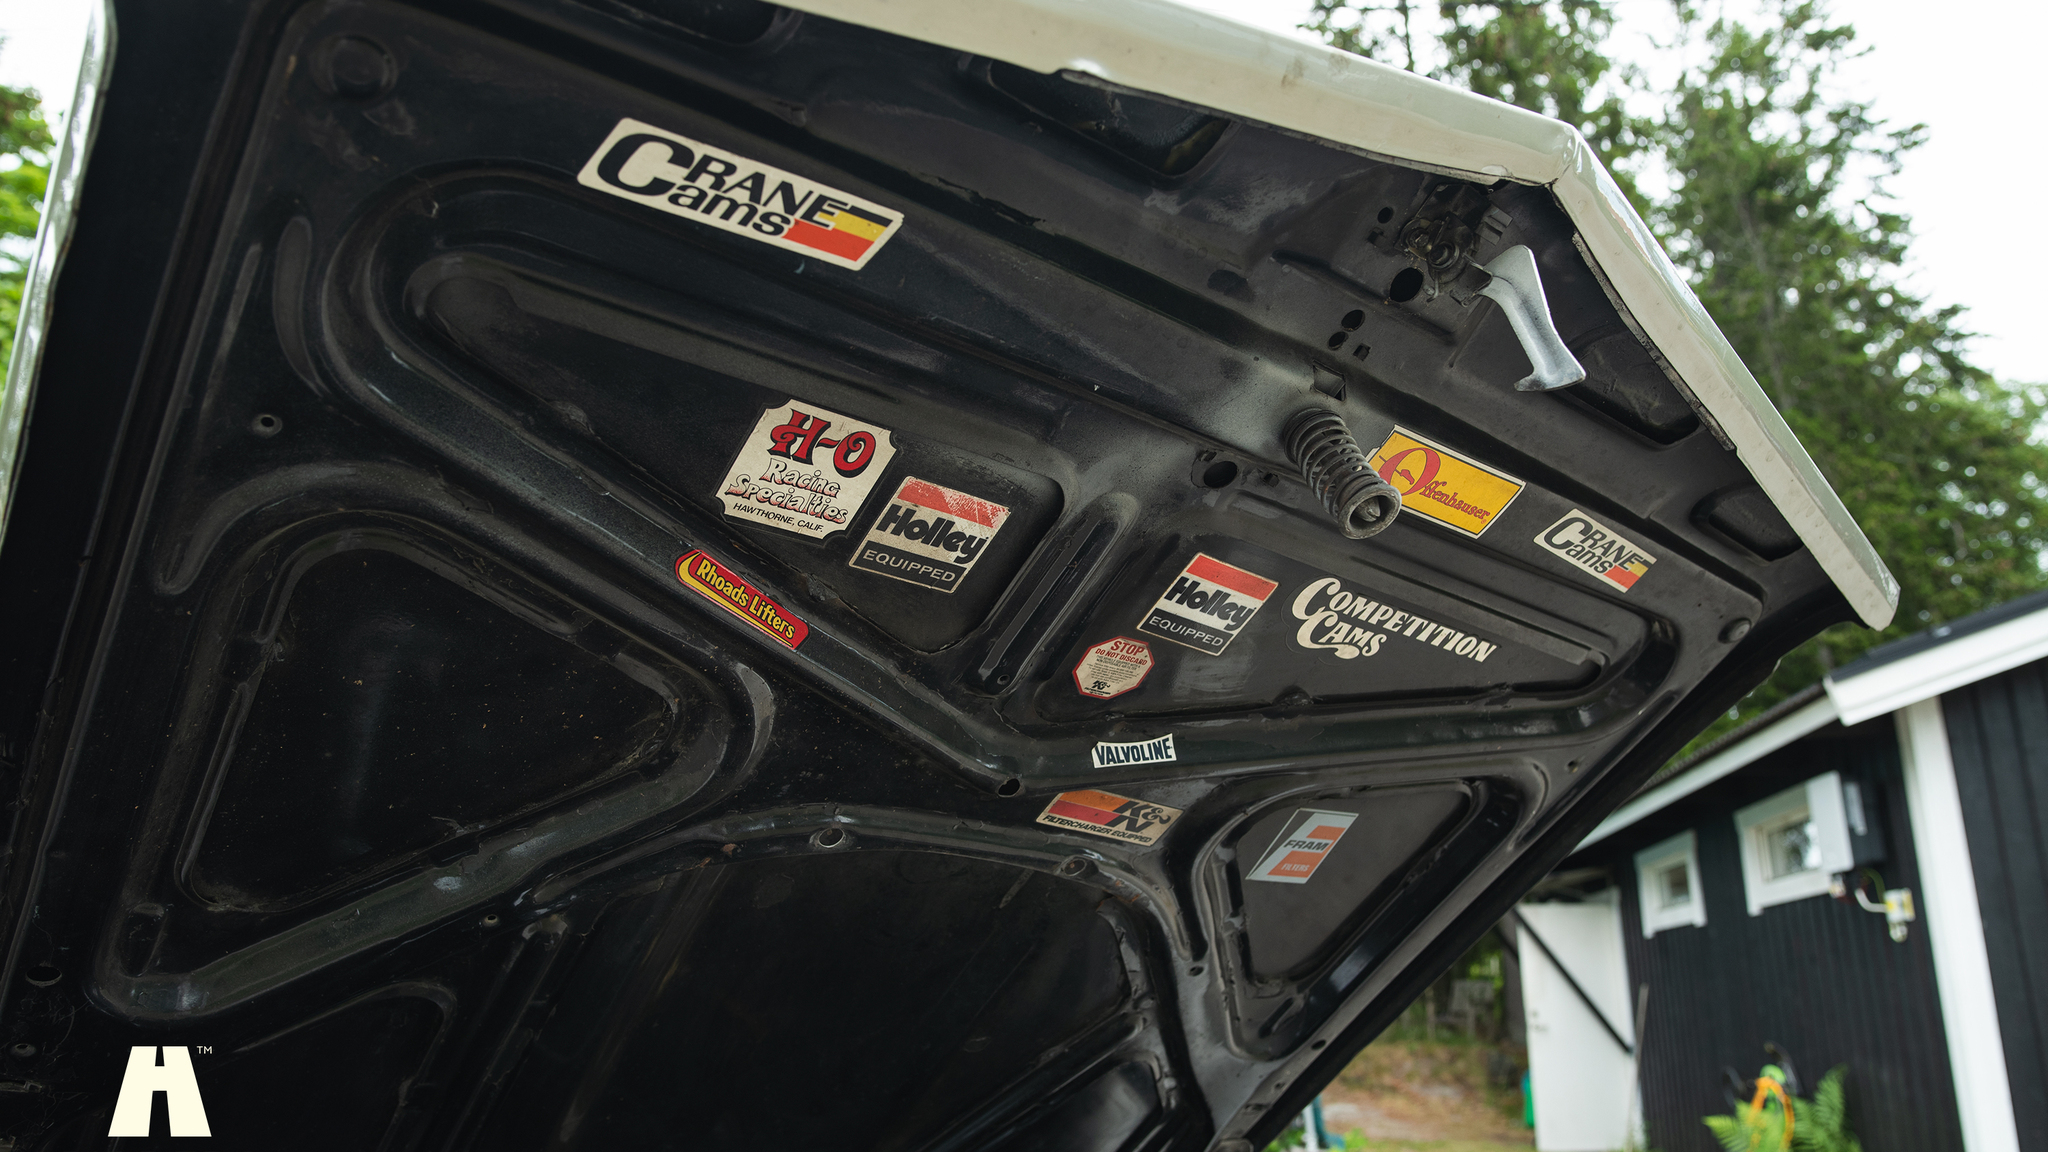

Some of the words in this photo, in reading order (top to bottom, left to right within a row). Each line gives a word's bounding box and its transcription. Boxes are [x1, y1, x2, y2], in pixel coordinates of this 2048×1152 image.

[597, 133, 850, 229] CRANE
[767, 408, 876, 478] H-O
[733, 502, 795, 526] HAWTHORNE,
[797, 519, 824, 533] CALIF.
[876, 503, 989, 565] Holley
[1544, 517, 1643, 571] CRANE
[863, 549, 956, 582] EQUIPPED
[696, 557, 749, 607] Rhoads
[748, 595, 796, 639] Lifters
[1164, 575, 1256, 631] Holley
[1149, 615, 1224, 647] EQUIPPED
[1291, 577, 1497, 663] COMPETITION
[1296, 607, 1388, 660] CAMS
[1095, 648, 1106, 656] DO
[1105, 650, 1120, 659] NOT
[1119, 653, 1148, 666] DISCARD
[1110, 640, 1145, 656] STOP
[1095, 737, 1173, 766] VALVOLINE
[1042, 814, 1113, 835] FILTERCHARGER
[1111, 830, 1153, 843] EQUIPPED
[1104, 800, 1171, 833] K&N
[1283, 839, 1330, 851] FRAM
[1281, 863, 1310, 872] FILTERS
